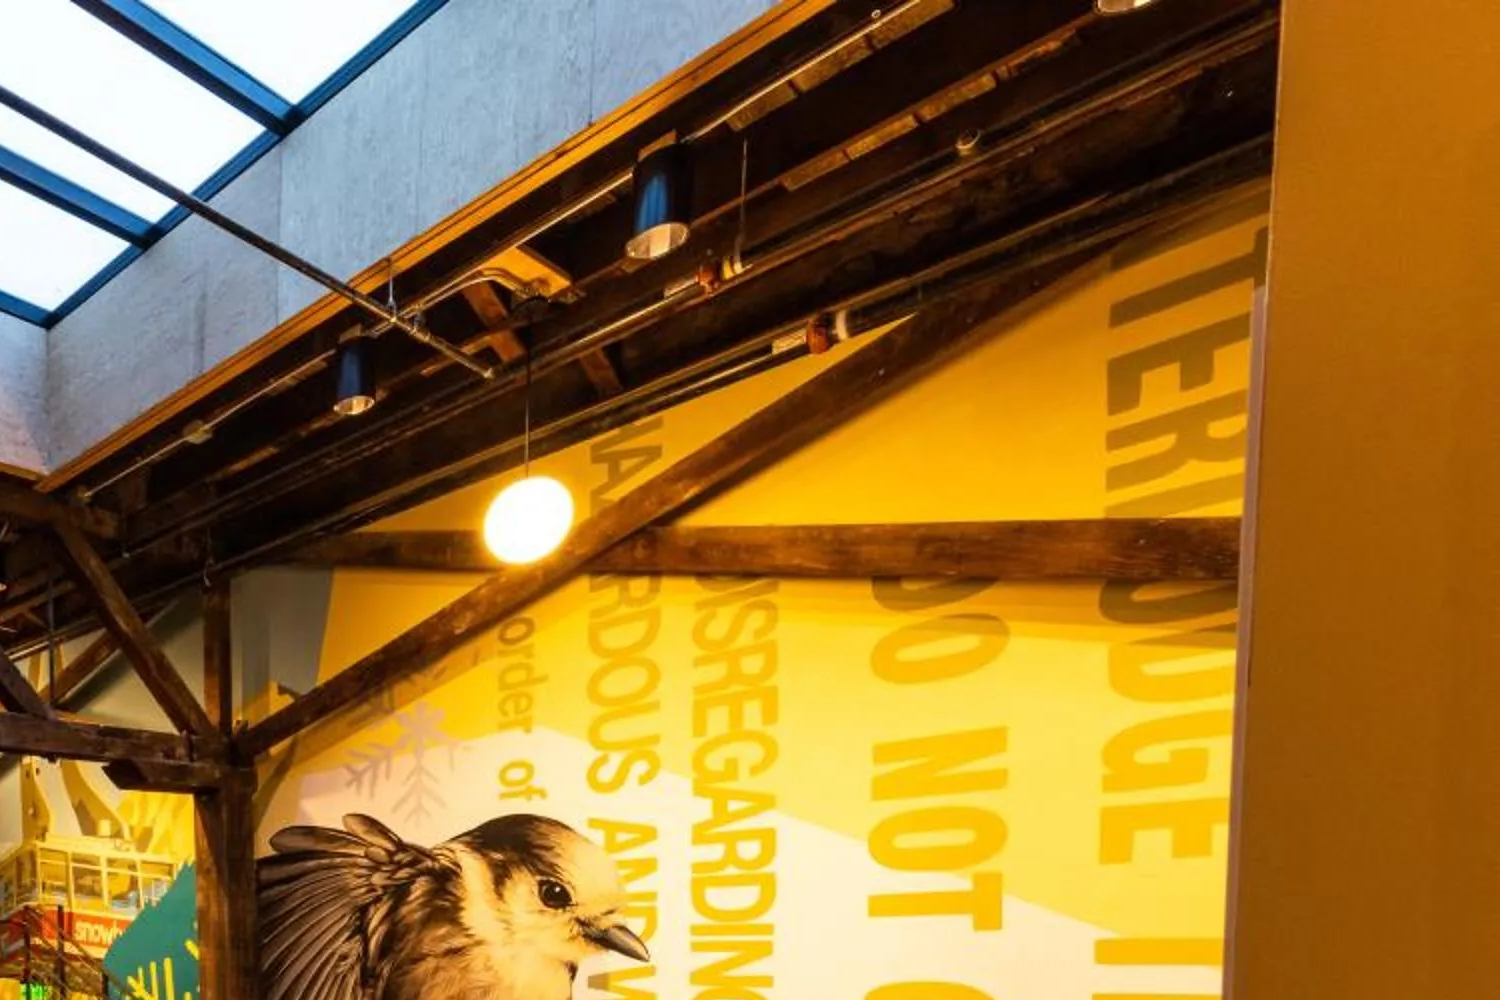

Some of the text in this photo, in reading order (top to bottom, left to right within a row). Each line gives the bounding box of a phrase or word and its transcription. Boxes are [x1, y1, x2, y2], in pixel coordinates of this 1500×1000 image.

[1098, 195, 1270, 865] TERLODGE
[498, 616, 549, 800] order of
[866, 726, 1010, 931] NOT
